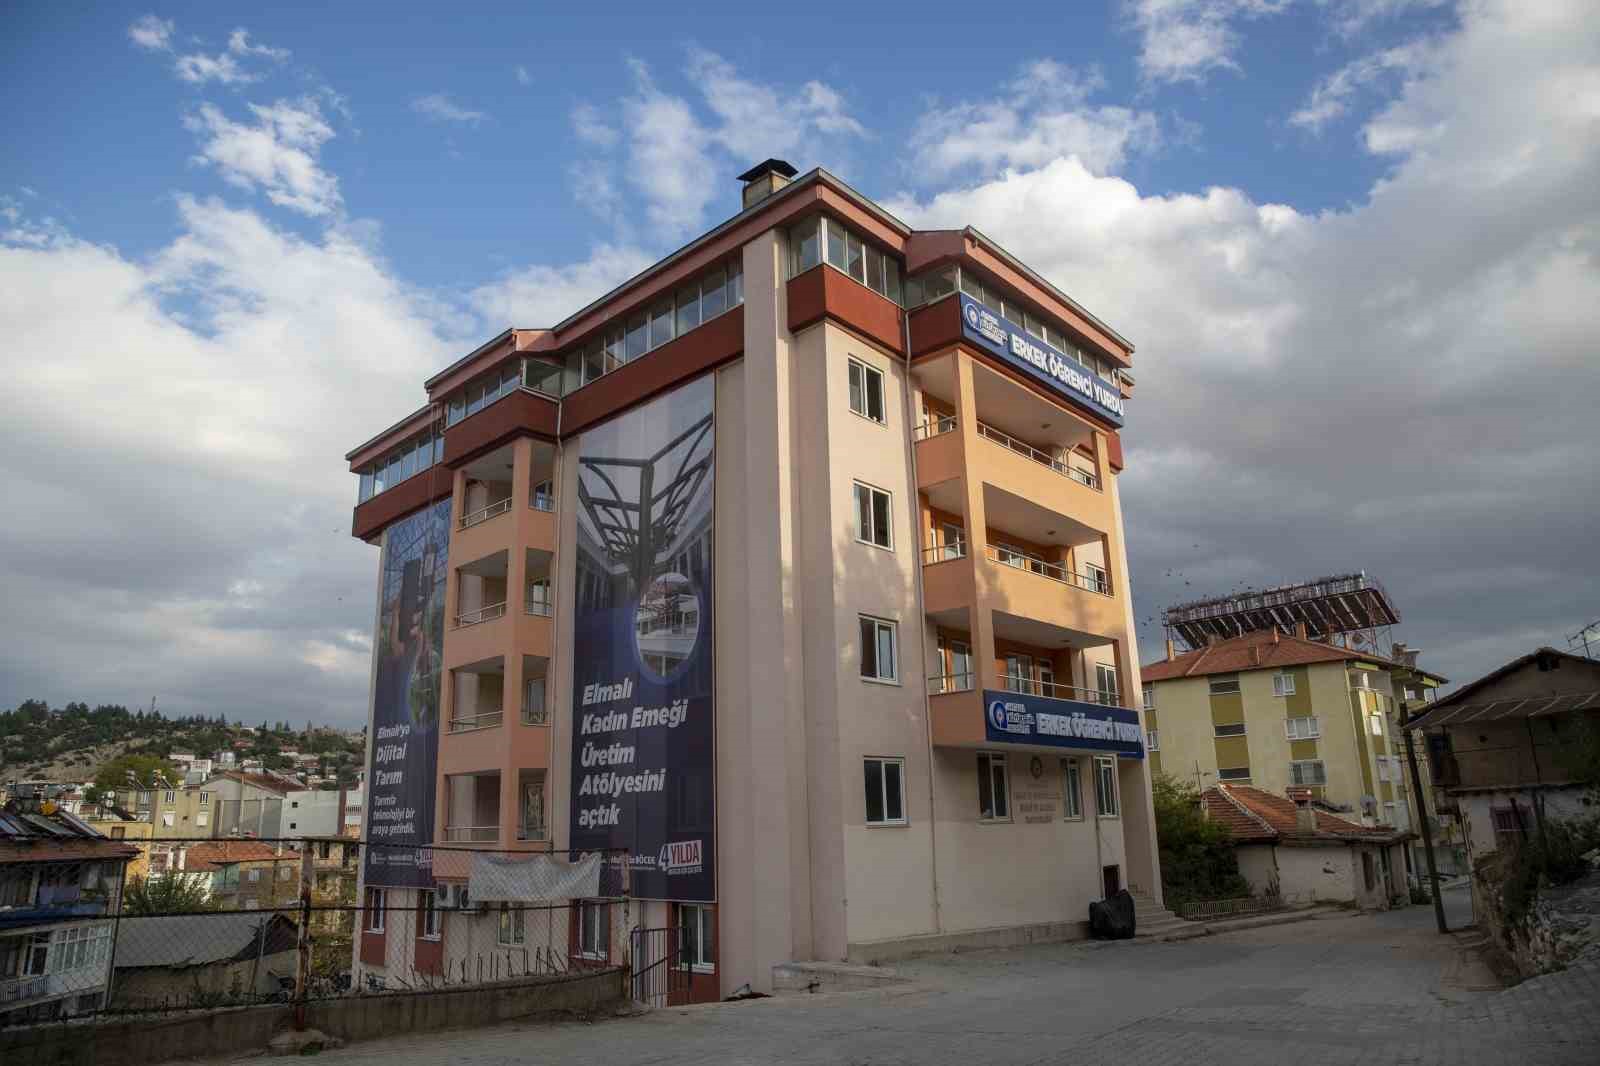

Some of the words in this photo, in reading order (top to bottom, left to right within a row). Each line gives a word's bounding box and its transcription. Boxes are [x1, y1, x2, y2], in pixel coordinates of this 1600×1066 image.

[1010, 333, 1049, 372] ERKEK
[1049, 352, 1094, 399] ÖĞRENCİ
[1093, 382, 1124, 416] YURDU
[582, 677, 633, 706] Elmalı
[581, 710, 628, 735] Kadın
[630, 699, 689, 729] Emeği
[1036, 712, 1073, 736] ERKEK
[376, 743, 407, 765] Dijital
[580, 742, 636, 767] Üretim
[375, 770, 403, 786] Tarım
[579, 768, 667, 797] Atölyesini
[578, 803, 621, 829] açtık
[671, 843, 701, 865] YILDA
